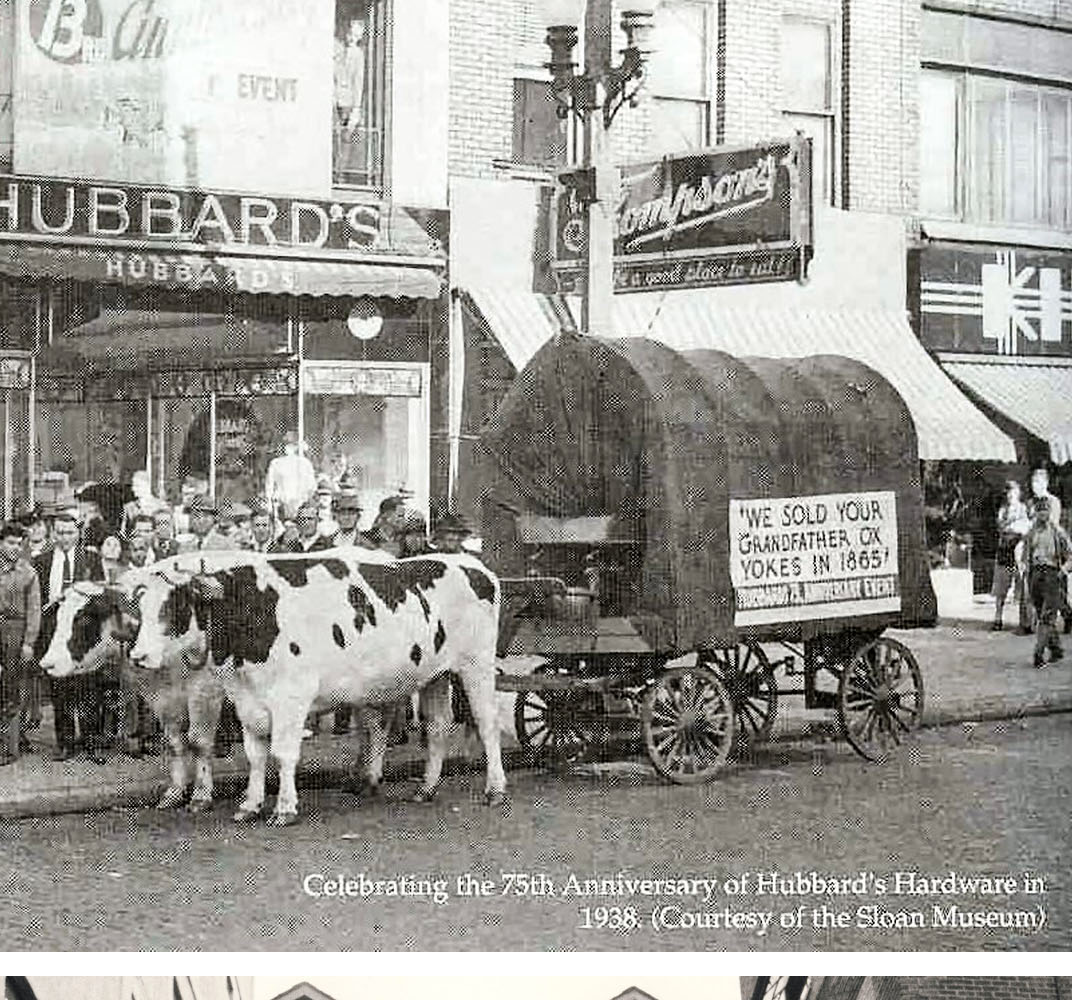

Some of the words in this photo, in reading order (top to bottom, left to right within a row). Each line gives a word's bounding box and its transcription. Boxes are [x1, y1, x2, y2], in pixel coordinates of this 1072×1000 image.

[237, 73, 298, 102] EVENT
[782, 504, 828, 527] SOLD
[837, 500, 883, 522] YOUR
[739, 529, 850, 555] GRANDFATHER
[859, 526, 883, 546] OX
[741, 556, 802, 579] YOKES
[813, 554, 830, 576] IN
